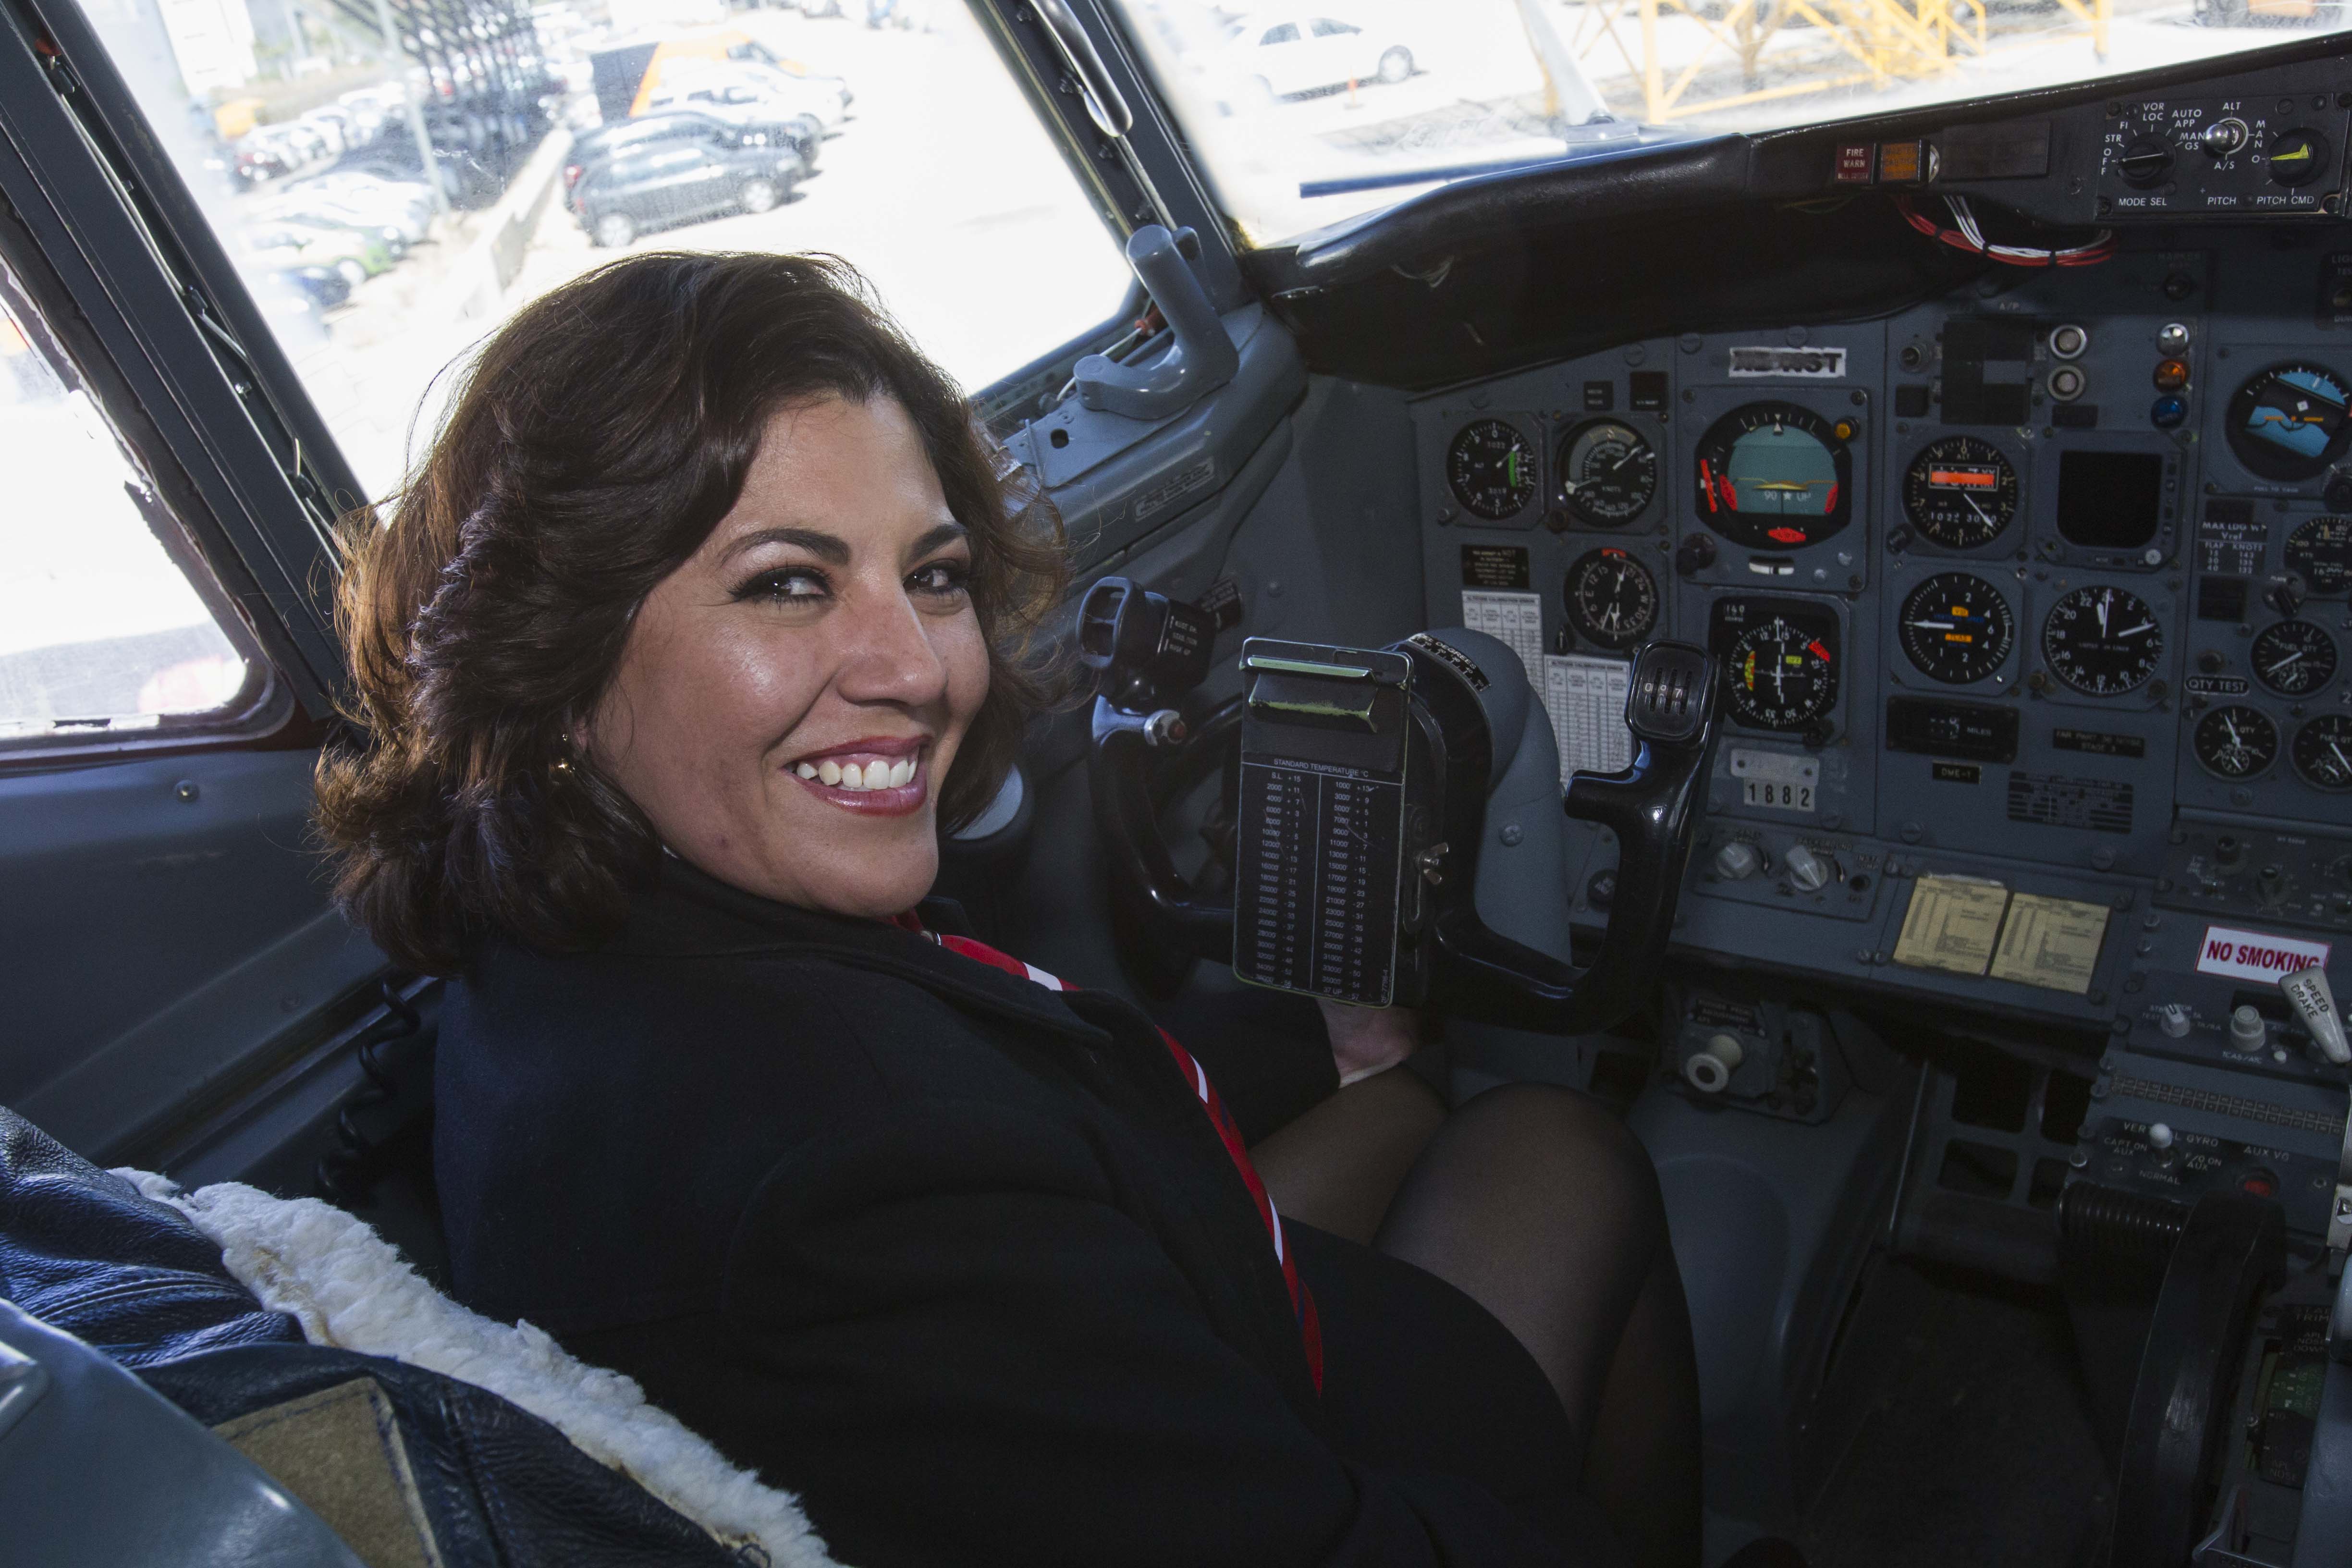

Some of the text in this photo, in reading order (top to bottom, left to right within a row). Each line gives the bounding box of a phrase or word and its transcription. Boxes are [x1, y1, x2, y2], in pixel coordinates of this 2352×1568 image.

[2143, 102, 2165, 111] VOR
[2222, 102, 2241, 110] ALT
[2143, 113, 2163, 121] LOC
[2172, 109, 2202, 118] AUTO
[2175, 119, 2195, 127] APP
[2105, 134, 2122, 143] STR
[2180, 132, 2205, 141] MAN
[2185, 142, 2199, 150] GS
[1846, 148, 1864, 157] FIRE
[1844, 159, 1865, 168] WARN
[2214, 161, 2235, 171] A/S
[2118, 197, 2168, 207] MODE SEL
[2207, 197, 2237, 206] PITCH
[2256, 195, 2315, 205] PITCH CMD
[2202, 521, 2225, 530] MAX
[2228, 522, 2247, 531] LDG
[2232, 542, 2263, 552] KNOTS
[2080, 597, 2092, 607] 22
[2064, 610, 2077, 620] 20
[1435, 641, 1477, 670] DEGREES
[2189, 678, 2245, 692] QTY TEST
[1274, 758, 1309, 769] STANDARD
[1310, 763, 1359, 776] TEMPERATURE
[1272, 772, 1283, 780] S.L.
[1749, 784, 1810, 808] 1882
[2206, 940, 2233, 962] NO
[2303, 978, 2329, 1013] SPEED
[2123, 1121, 2220, 1147] VERL GYRO
[2104, 1137, 2148, 1152] CAPT ON
[2114, 1147, 2134, 1157] AUX
[2243, 1145, 2268, 1158] AUX
[2186, 1161, 2208, 1172] AUX
[2207, 1157, 2222, 1167] ON
[2139, 1170, 2181, 1186] NORMAL
